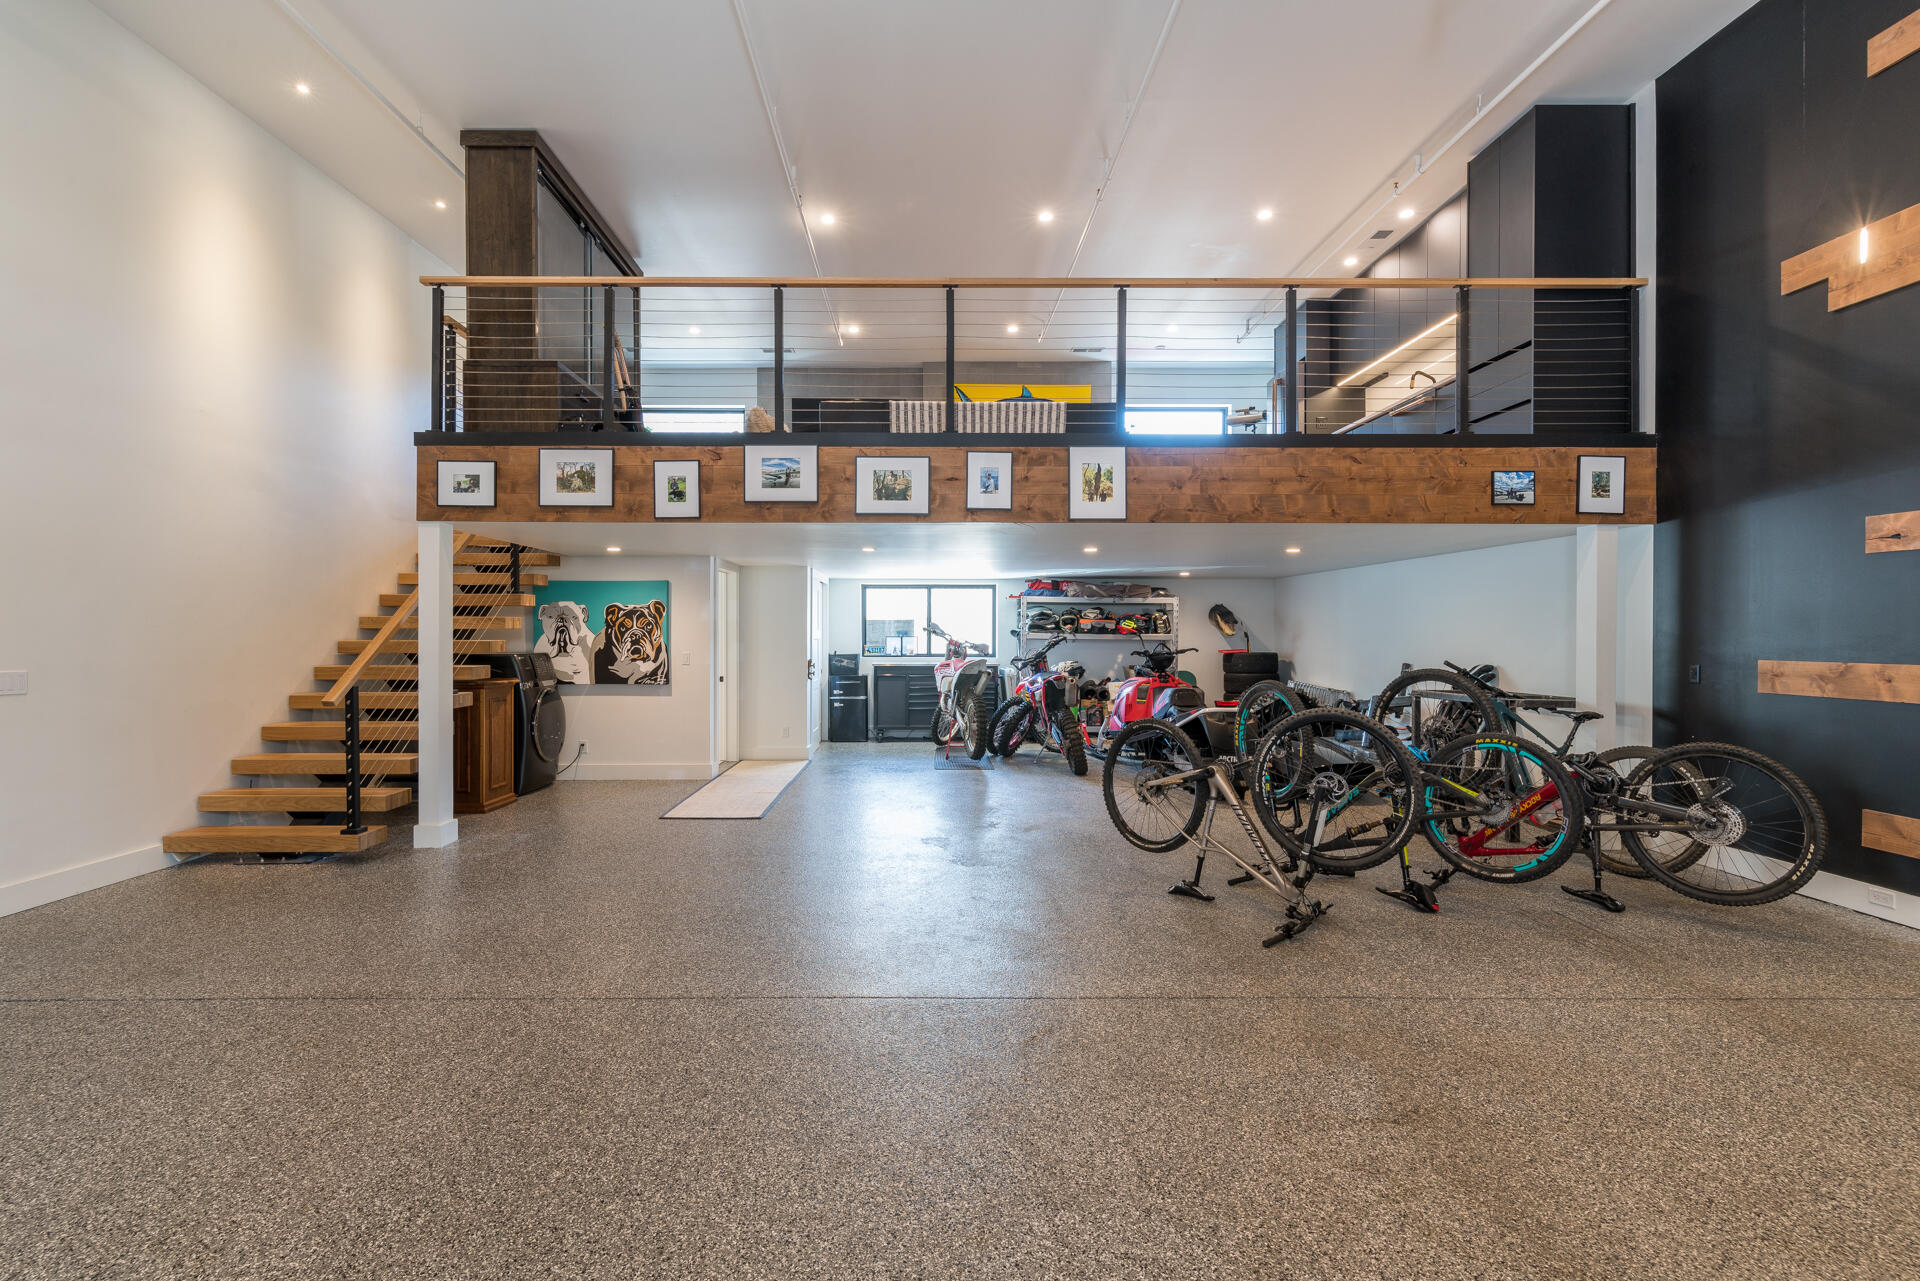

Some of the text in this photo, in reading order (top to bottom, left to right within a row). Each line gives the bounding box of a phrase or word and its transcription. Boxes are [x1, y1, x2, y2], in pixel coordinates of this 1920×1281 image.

[1475, 738, 1519, 748] MAXXIS
[1519, 793, 1542, 813] ROCKY
[1791, 842, 1815, 881] MAXXIS
